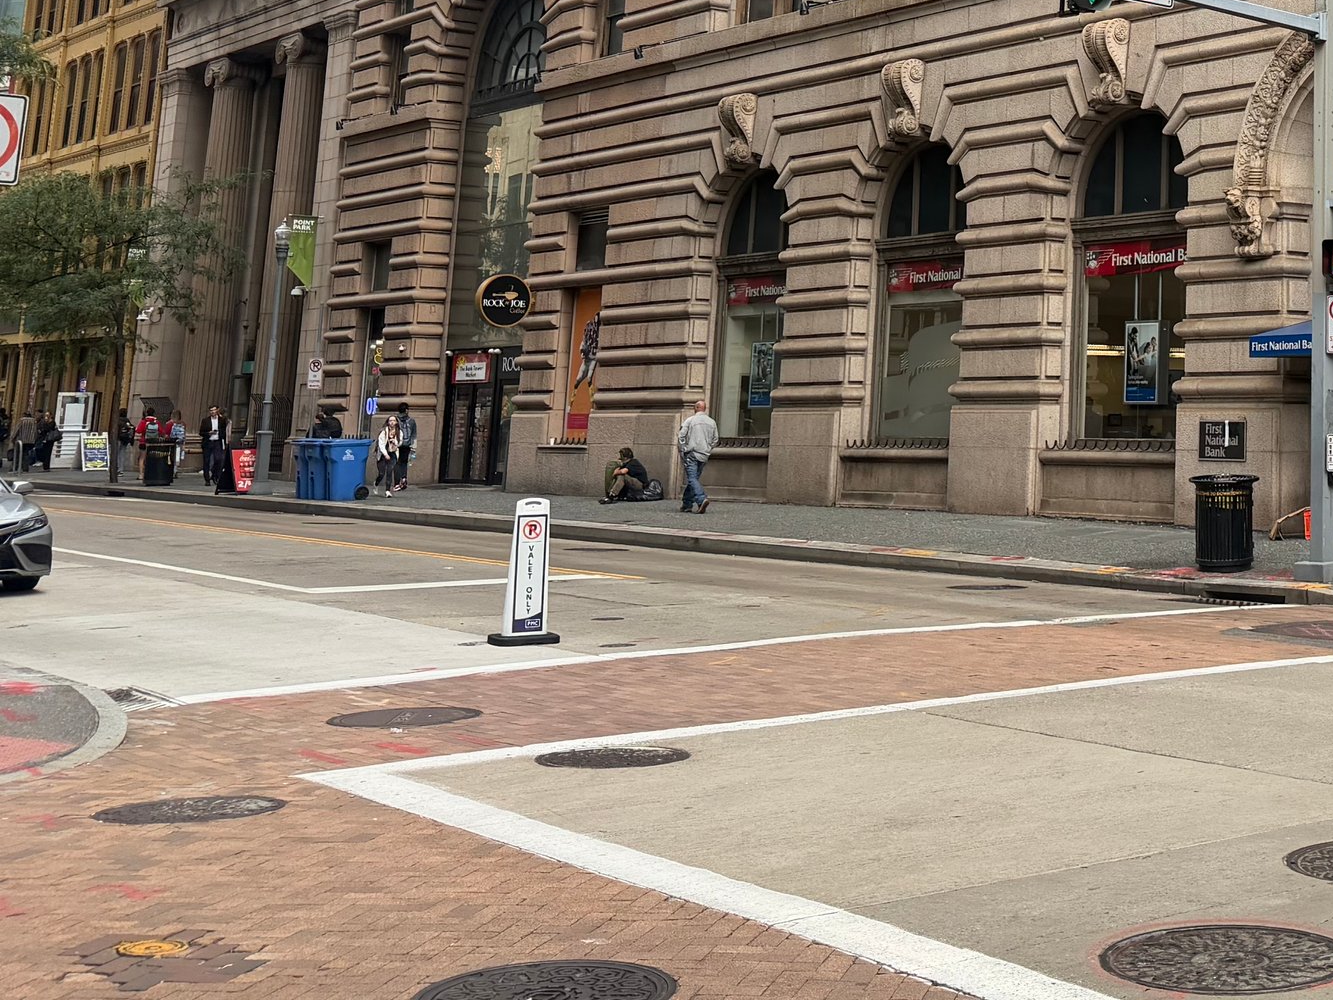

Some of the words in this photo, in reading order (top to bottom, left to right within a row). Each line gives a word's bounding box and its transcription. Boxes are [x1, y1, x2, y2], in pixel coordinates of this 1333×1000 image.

[1111, 252, 1133, 267] First
[1134, 249, 1175, 265] National
[909, 271, 927, 284] First
[927, 267, 961, 282] National
[745, 286, 760, 297] First
[760, 284, 788, 296] Nationa
[483, 298, 505, 308] ROCK
[510, 299, 527, 308] JOE
[1251, 341, 1268, 352] First
[1269, 340, 1300, 351] National
[1301, 340, 1312, 349] Ba
[502, 357, 522, 372] ROC
[1205, 423, 1222, 434] First
[1205, 446, 1226, 457] Bank
